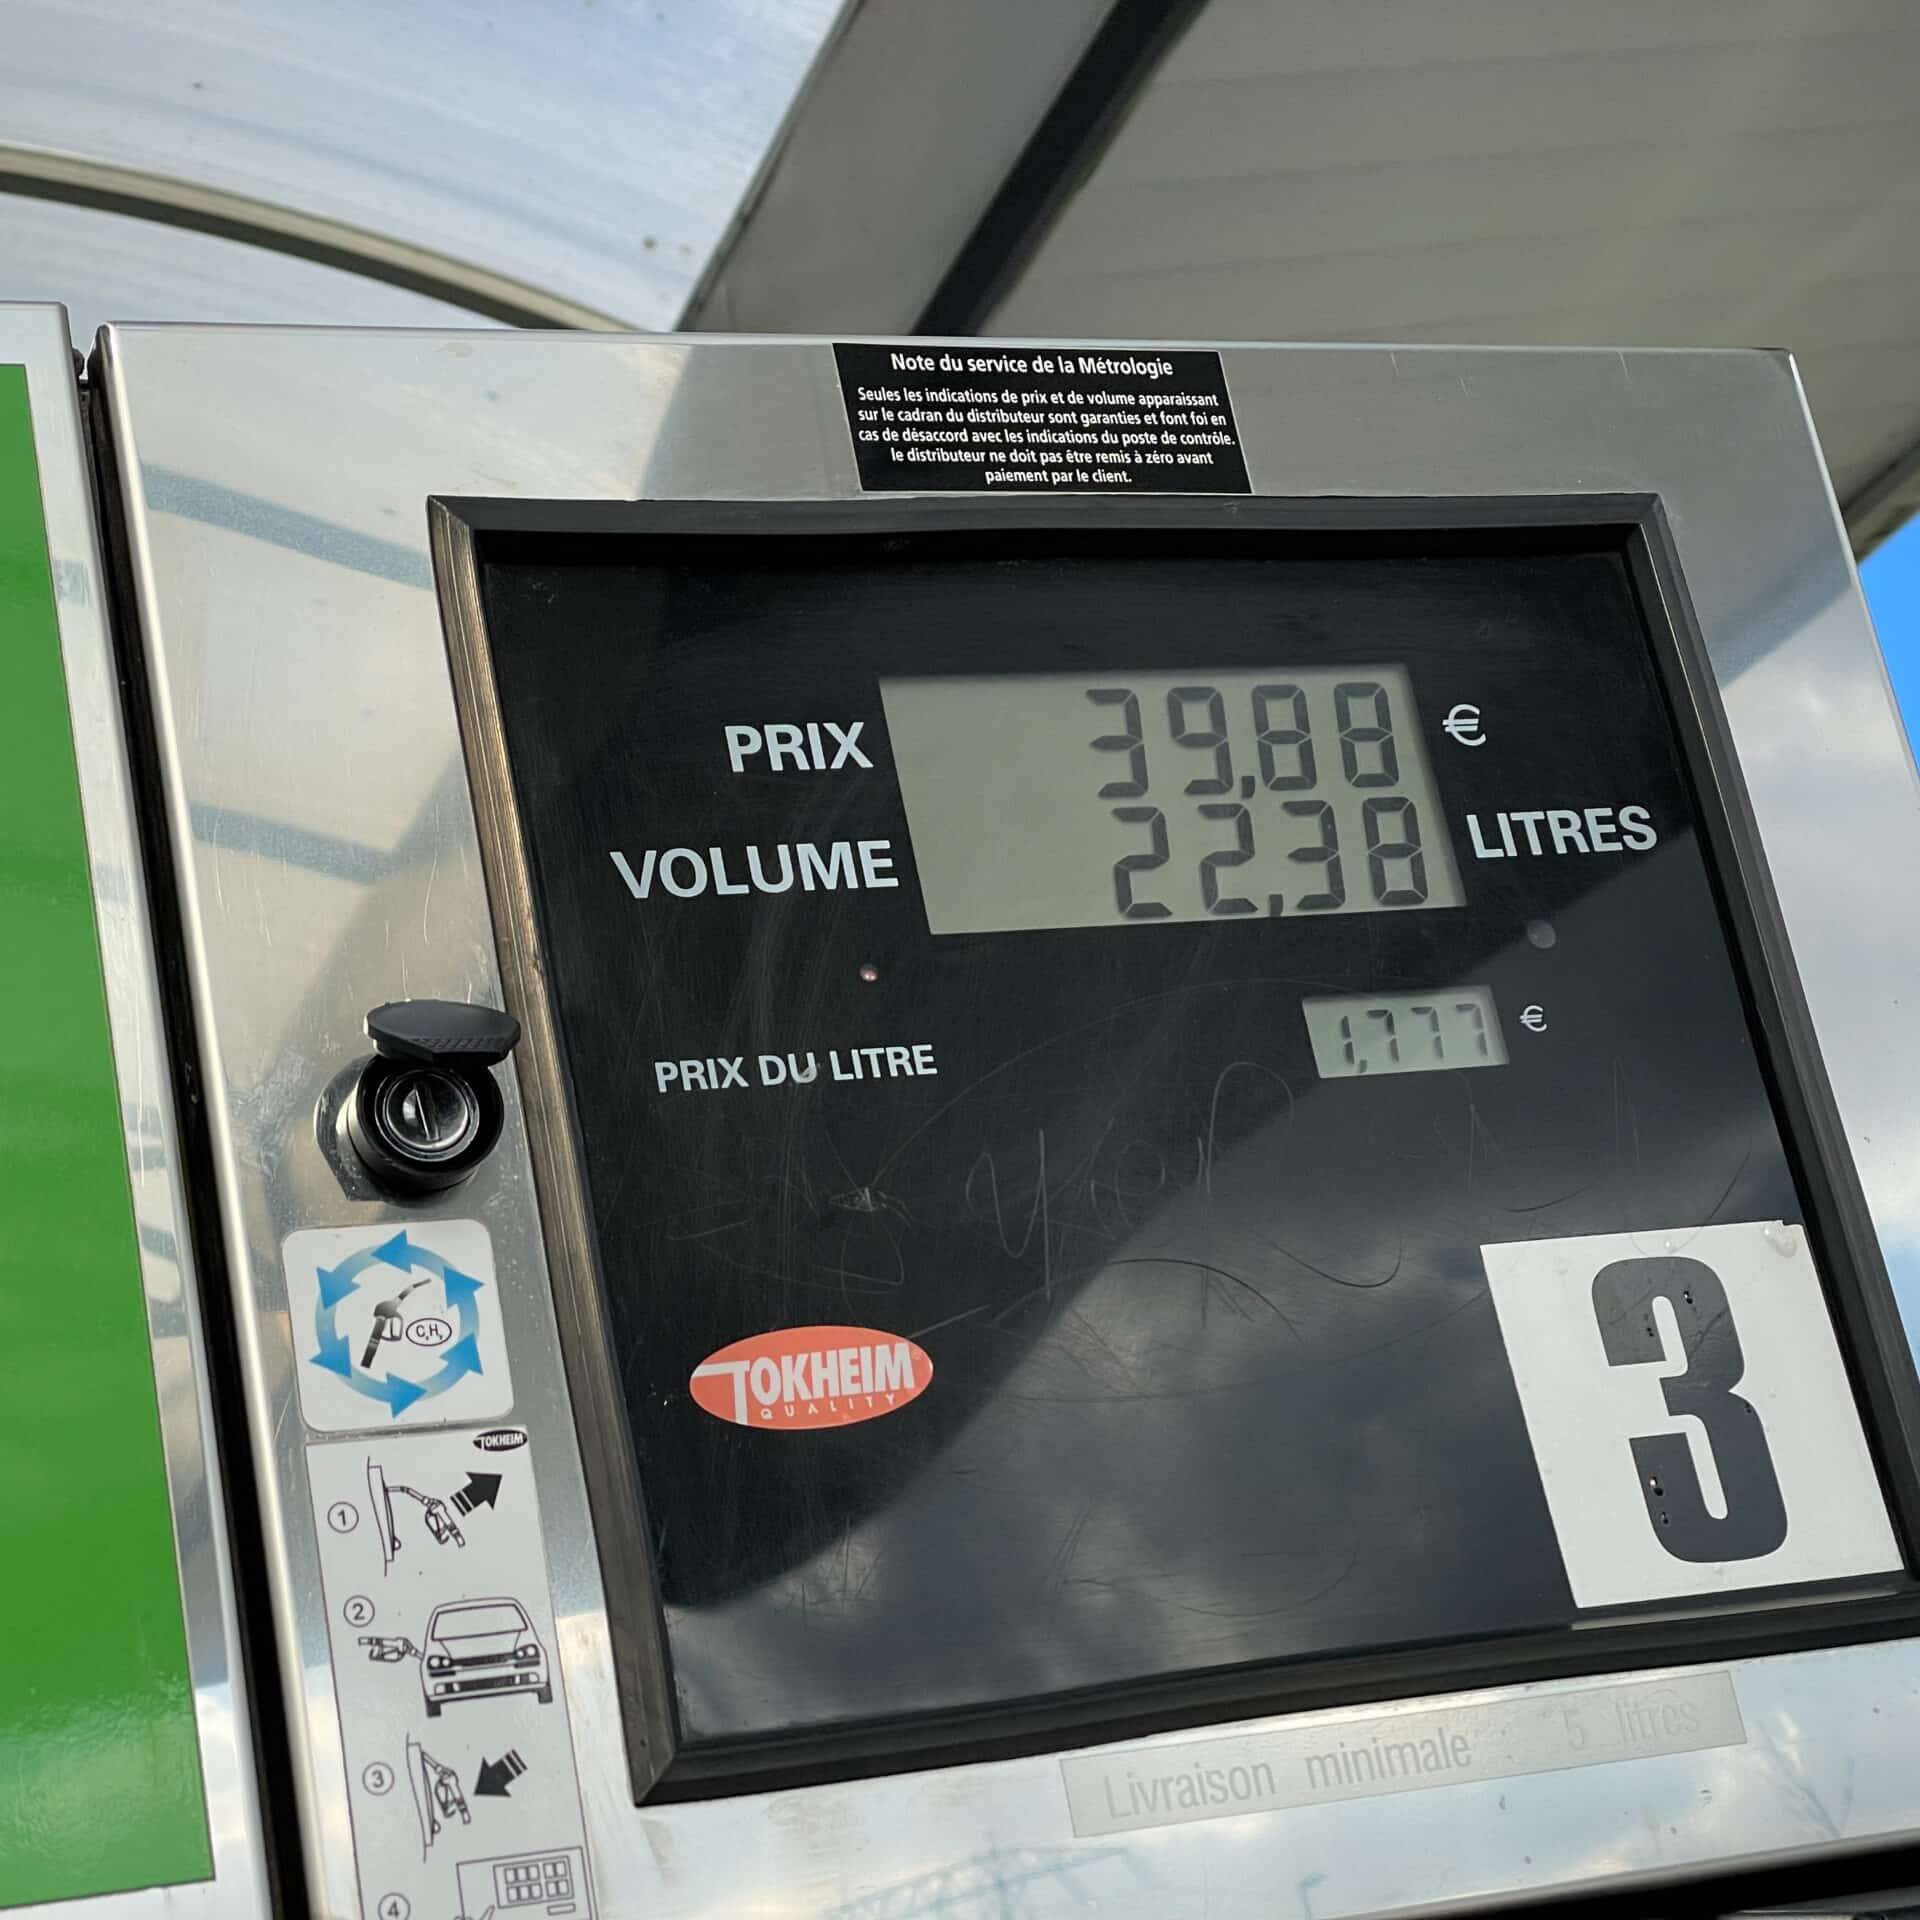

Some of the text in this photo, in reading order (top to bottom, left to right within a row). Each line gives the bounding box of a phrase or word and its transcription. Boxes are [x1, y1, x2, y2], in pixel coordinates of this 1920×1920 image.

[890, 353, 1174, 379] Note du service de la Métrologie
[857, 386, 1219, 408] Seules les indications de prix et de volume apparaissant
[857, 407, 1227, 427] sur le cadran du distributeur sont garanties et font foi en
[858, 427, 1236, 447] cas de désaccord avec les indications du poste de contrôle.
[907, 447, 986, 463] distributeur
[989, 451, 1006, 463] ne
[1009, 448, 1037, 463] doit
[1040, 452, 1063, 466] pas
[1066, 449, 1093, 463] être
[1096, 450, 1132, 464] remis
[1134, 450, 1143, 464] à
[1145, 450, 1174, 464] zéro
[1177, 452, 1214, 465] avant
[984, 468, 1133, 485] paiement par le client.
[724, 721, 875, 773] PRIX
[1466, 804, 1657, 858] LITRES
[609, 839, 899, 900] VOLUME
[1111, 796, 1429, 917] 22,38
[654, 1044, 938, 1093] PRIX DU LITRE
[691, 1342, 916, 1426] TOKHEIM
[760, 1393, 895, 1420] QUALITY
[1591, 1256, 1788, 1563] 3
[475, 1432, 525, 1450] TOKHEIM
[351, 1604, 366, 1622] 2
[372, 1770, 385, 1788] 3
[1103, 1761, 1277, 1819] Livraison
[1305, 1727, 1473, 1789] minimale
